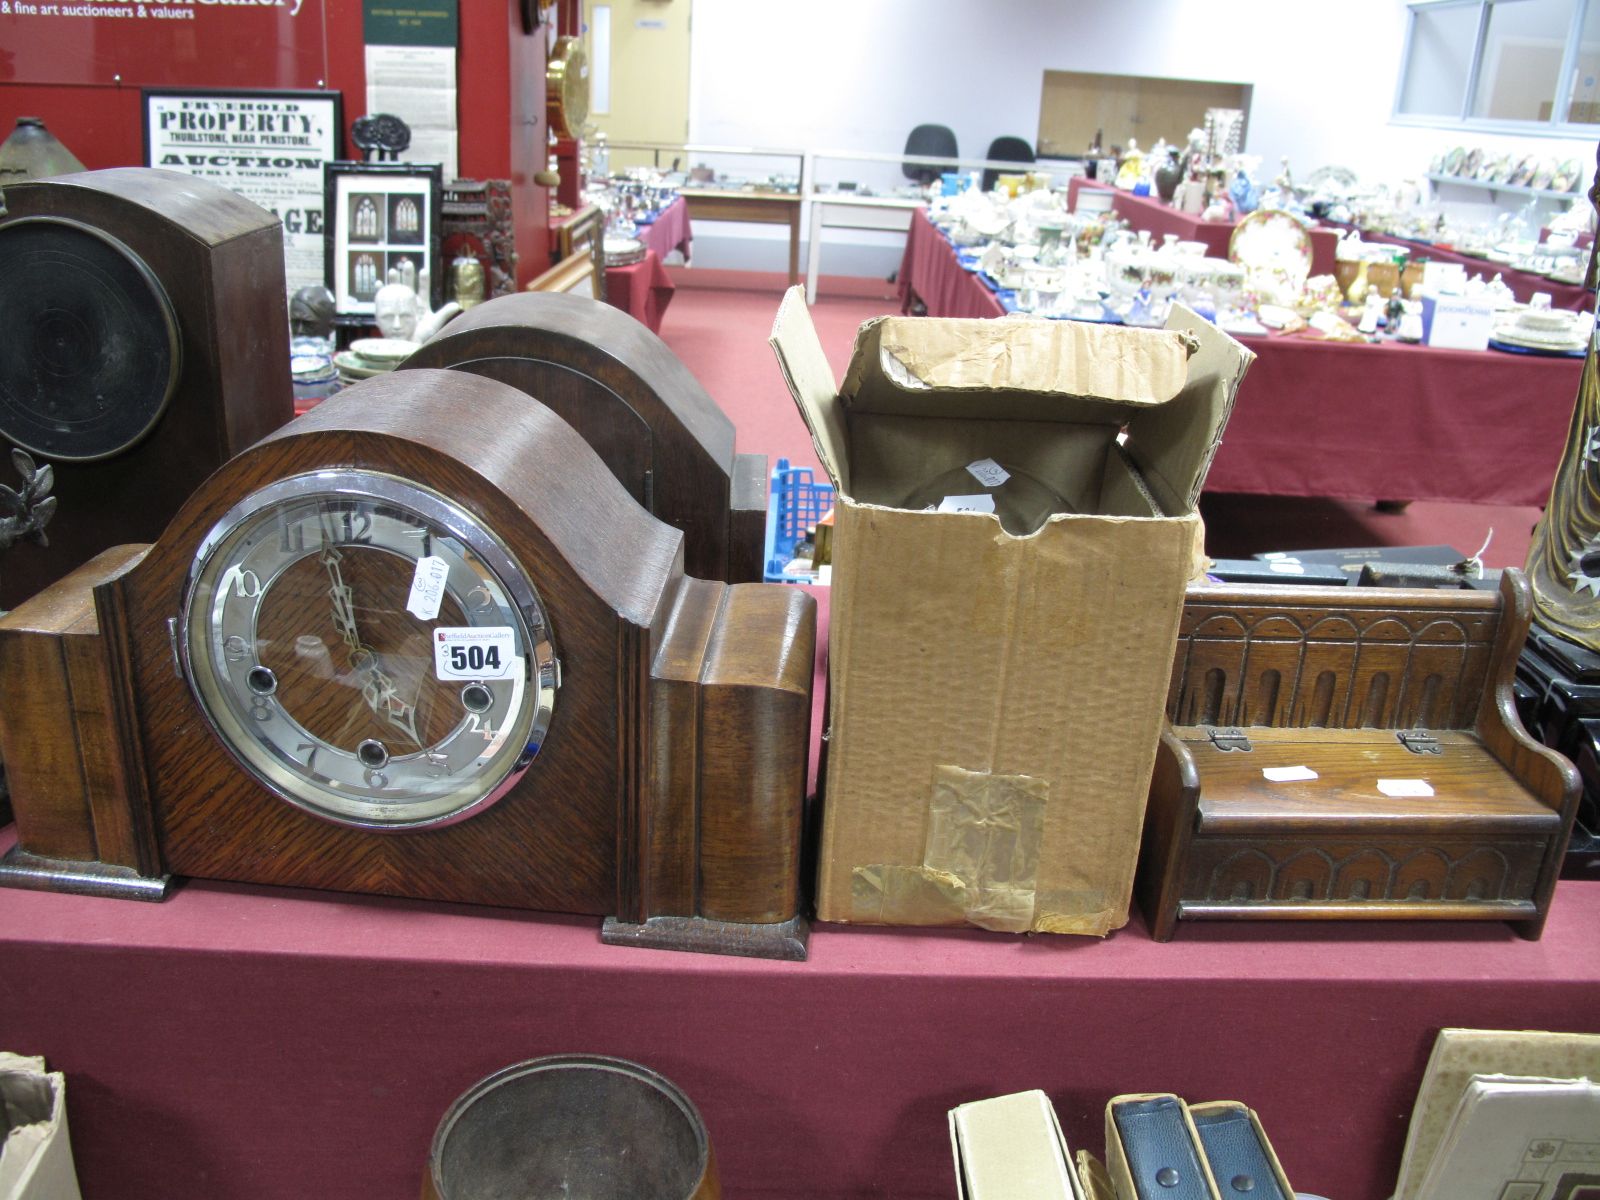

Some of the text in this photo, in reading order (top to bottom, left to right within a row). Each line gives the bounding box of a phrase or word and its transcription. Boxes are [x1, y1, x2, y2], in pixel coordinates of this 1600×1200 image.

[1, 1, 194, 19] & fine art auctioneers & valuers
[160, 111, 323, 137] PROPERTY,
[170, 132, 312, 147] THURLSTONE, NEAR PENISTONE.
[160, 154, 322, 169] AUCTION
[342, 512, 372, 544] 12
[234, 566, 262, 598] 10
[451, 645, 501, 671] 504
[250, 694, 273, 722] 8
[297, 743, 318, 775] 7
